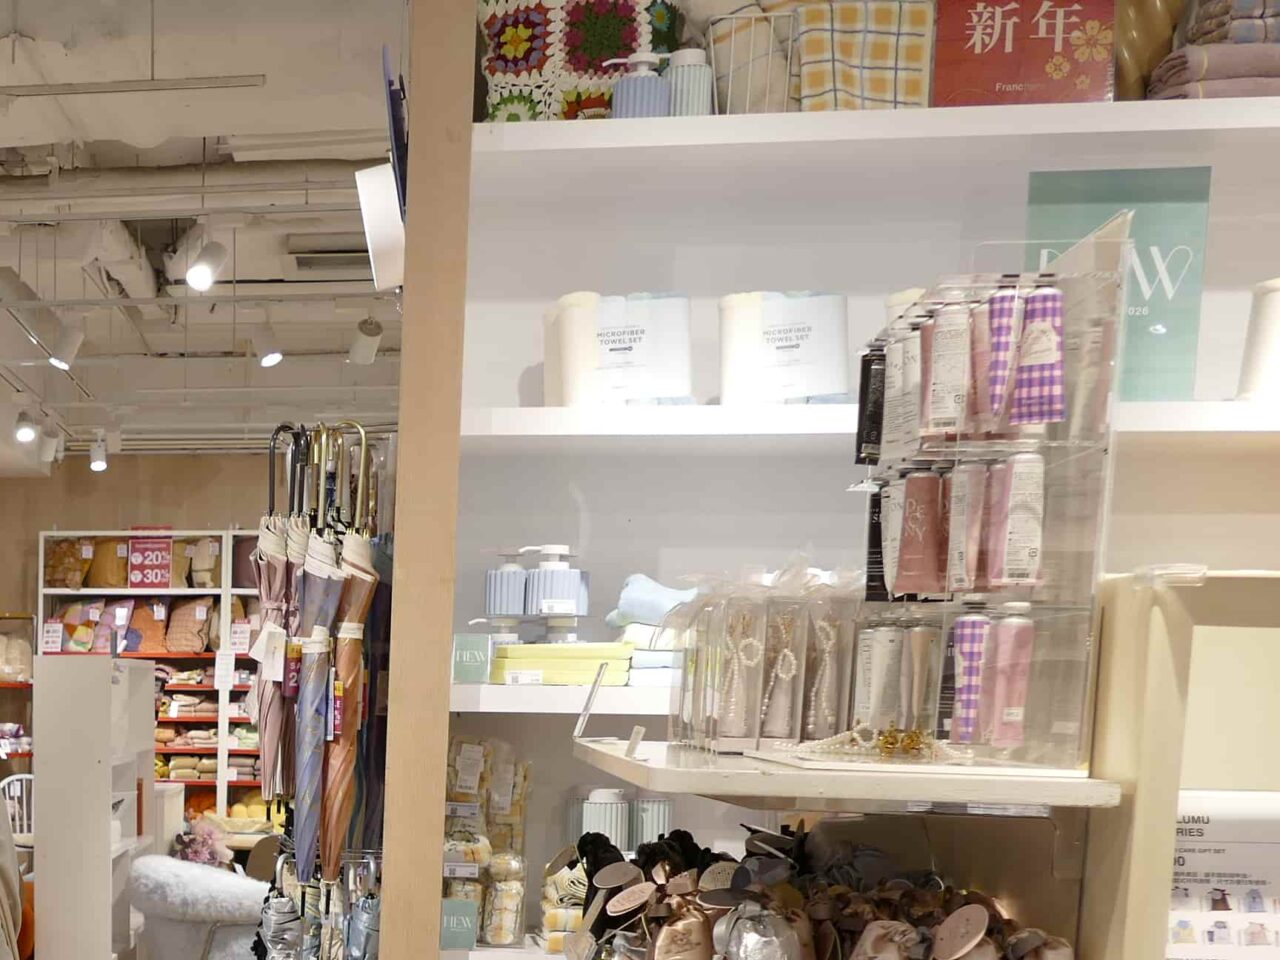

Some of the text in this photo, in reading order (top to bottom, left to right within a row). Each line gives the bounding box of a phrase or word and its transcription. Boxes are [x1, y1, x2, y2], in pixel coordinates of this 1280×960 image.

[964, 1, 1083, 54] 新年
[1128, 306, 1149, 316] 026
[596, 328, 646, 338] MICROFIBER
[762, 326, 813, 337] MICROFIBER
[599, 336, 643, 346] TOWEL SET
[765, 333, 810, 344] TOWEL SET
[1176, 827, 1205, 837] RIES
